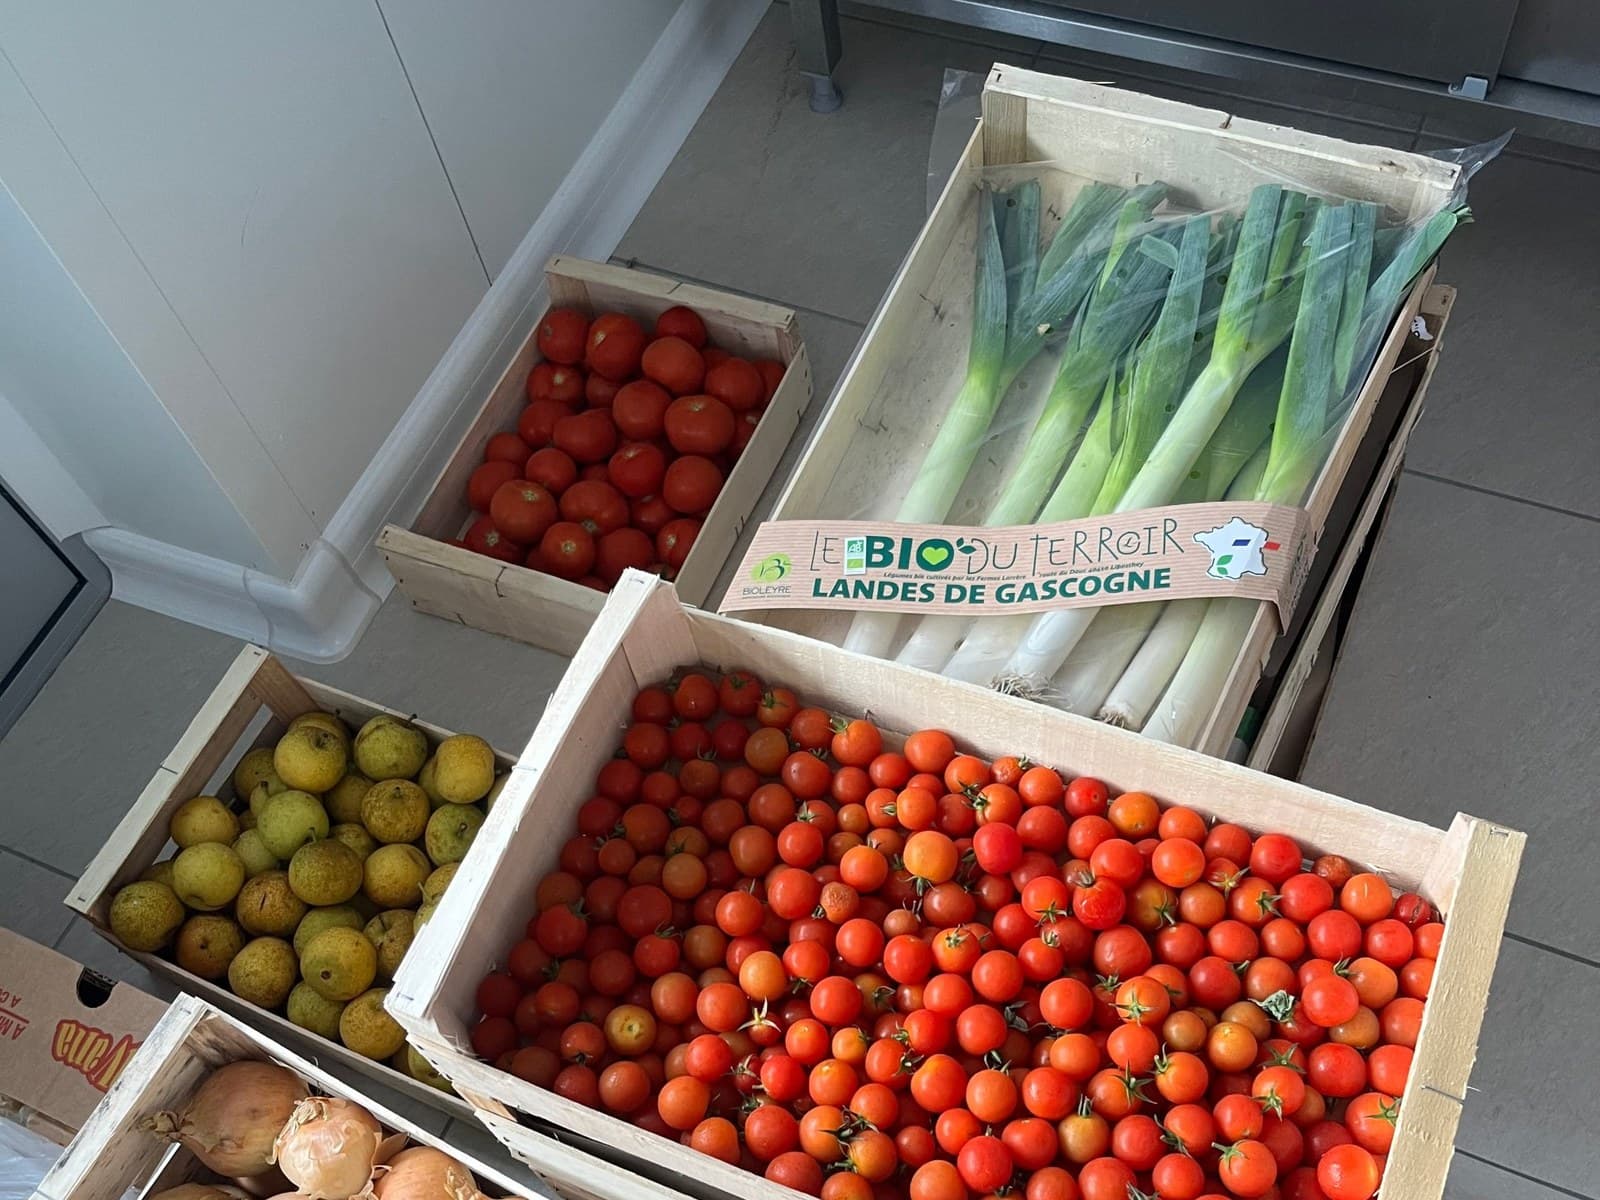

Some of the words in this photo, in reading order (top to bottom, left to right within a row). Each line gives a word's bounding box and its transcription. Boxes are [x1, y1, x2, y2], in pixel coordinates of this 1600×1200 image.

[810, 531, 840, 572] LE
[865, 535, 955, 572] BIO
[967, 538, 1018, 575] DU
[1030, 518, 1185, 577] TERROIR
[742, 585, 792, 596] BIOLEYRE
[812, 578, 936, 603] LANDES
[944, 583, 986, 604] DE
[994, 567, 1172, 604] GASCOGNE
[11, 994, 22, 1008] A
[11, 1023, 26, 1041] A
[52, 1019, 144, 1093] Vana
